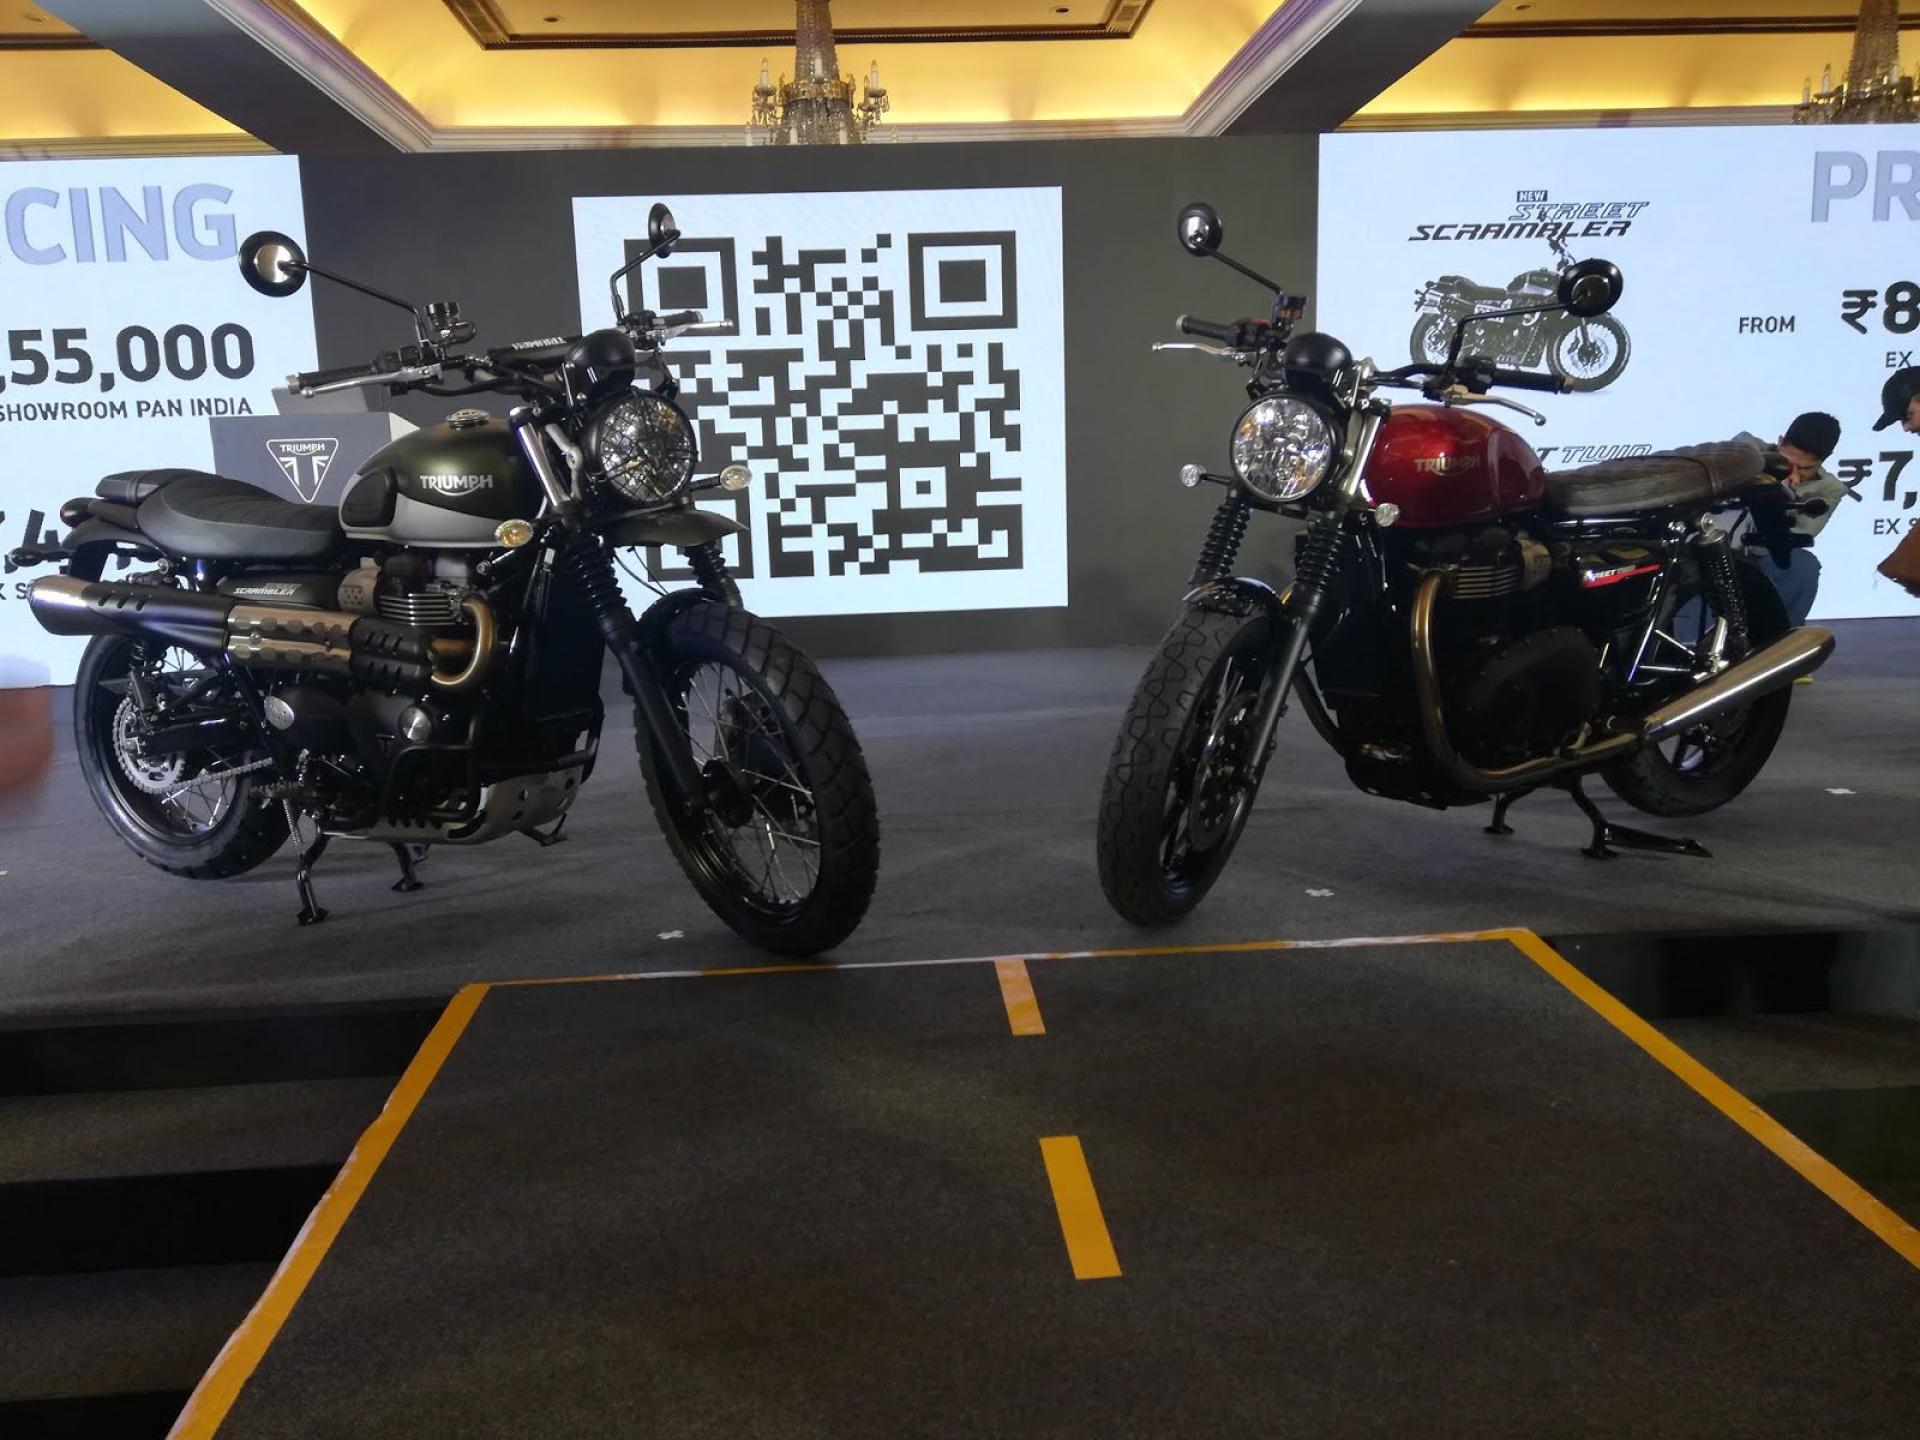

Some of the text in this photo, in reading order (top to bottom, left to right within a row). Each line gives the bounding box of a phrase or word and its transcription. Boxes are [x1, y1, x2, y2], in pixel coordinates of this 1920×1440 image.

[1517, 190, 1547, 202] NEW
[1508, 201, 1650, 221] STREET
[4, 183, 238, 266] CING
[1408, 220, 1632, 241] SCRAMBLER
[1738, 315, 1796, 334] FROM
[1885, 351, 1913, 369] EX
[136, 398, 182, 418] PAN
[191, 397, 253, 416] INDIA
[280, 443, 325, 455] TRIUMPH
[1414, 456, 1480, 476] TRIUMPH
[420, 474, 493, 496] TRIUMPH
[1873, 517, 1901, 535] EX
[233, 587, 296, 596] SCRAMBLER
